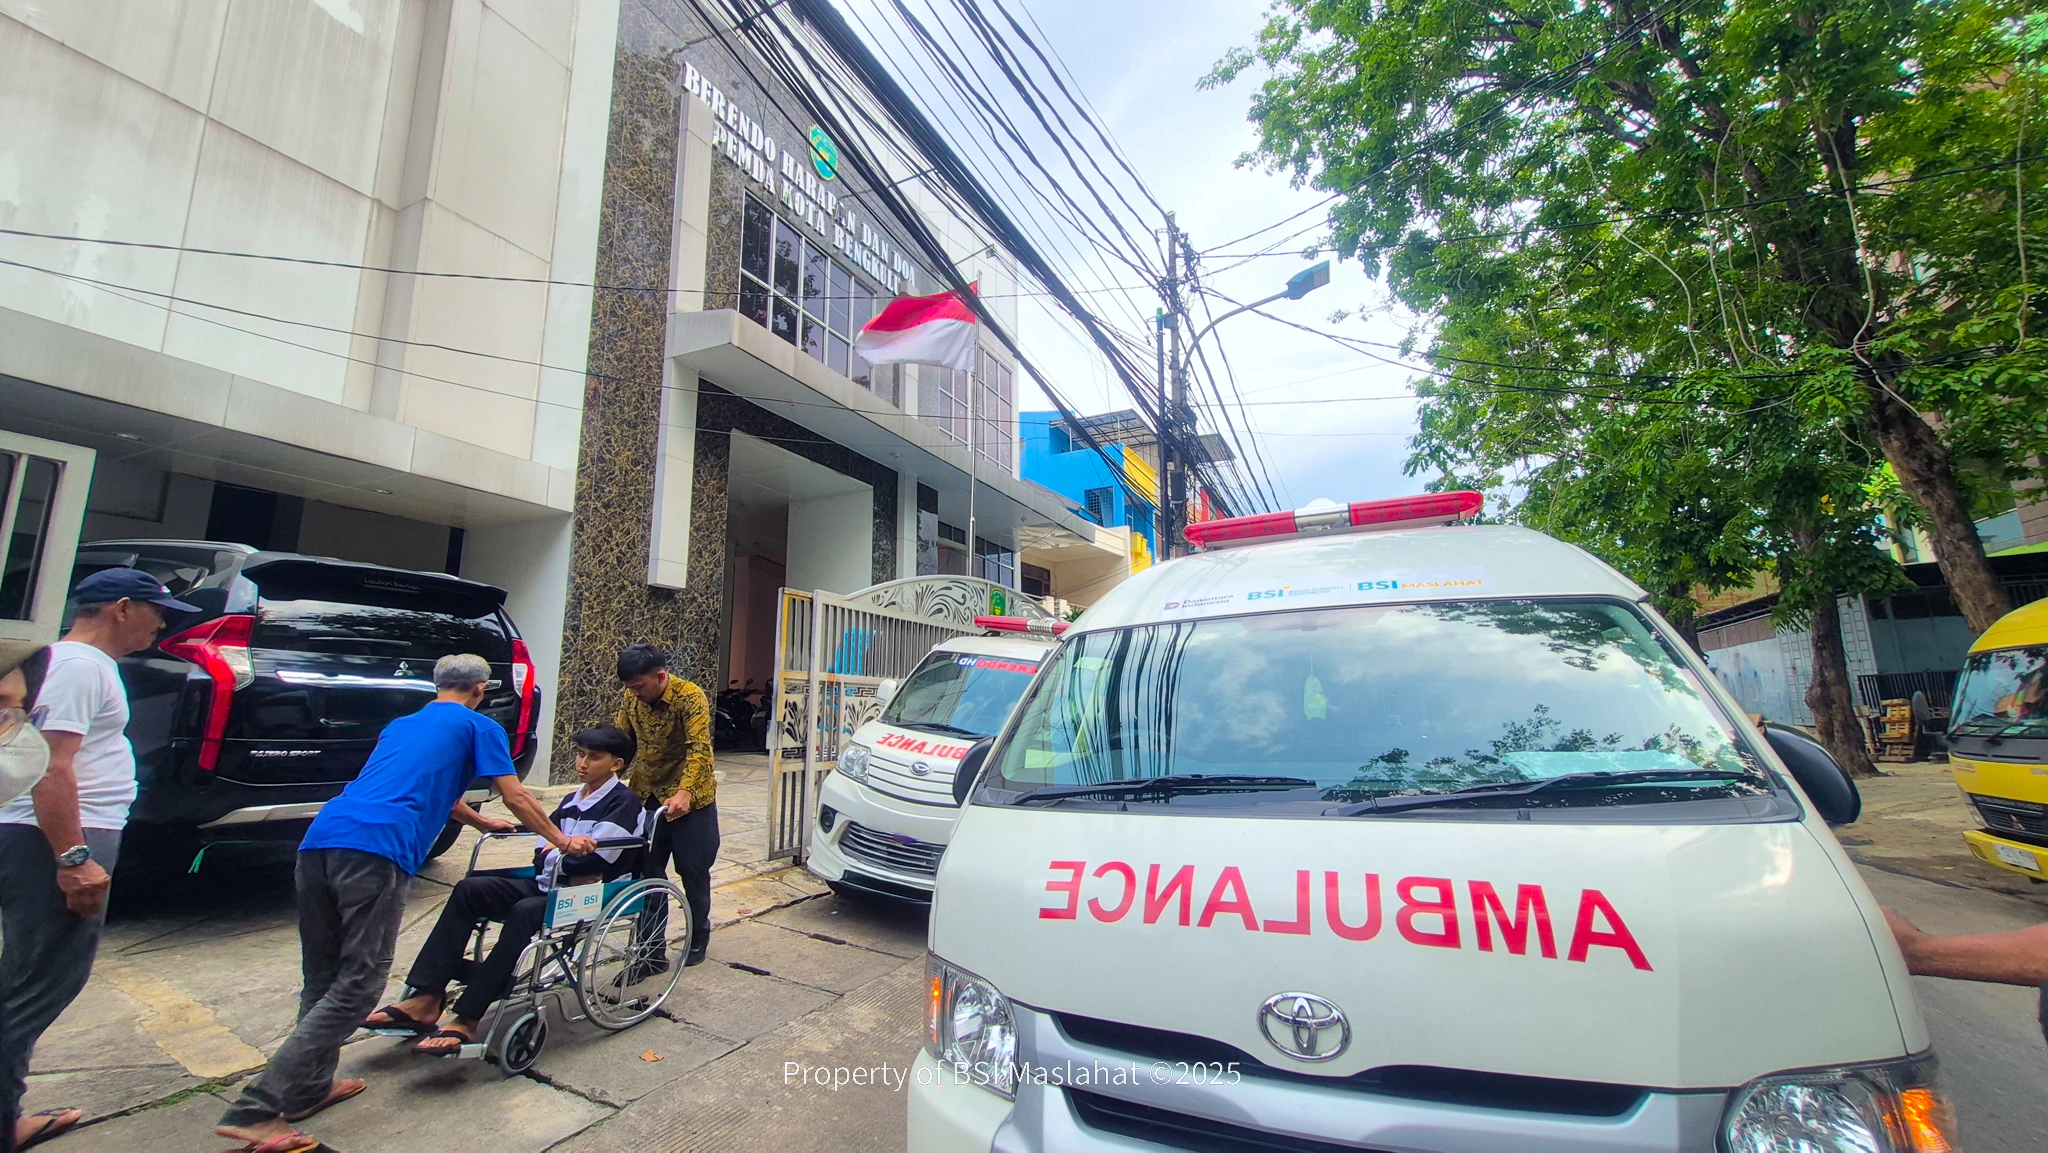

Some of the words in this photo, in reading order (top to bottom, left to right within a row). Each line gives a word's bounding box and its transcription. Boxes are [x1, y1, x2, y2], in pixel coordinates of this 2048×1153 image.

[683, 61, 776, 161] BERENDO
[862, 222, 889, 264] DAN
[893, 250, 916, 287] DOA
[712, 120, 776, 195] PEMDA
[781, 179, 826, 237] KOTA
[833, 223, 901, 297] BENGKULU
[1357, 580, 1398, 591] BSI
[1402, 579, 1484, 589] MASLAHAT
[1183, 594, 1234, 605] Danantara
[1247, 588, 1284, 600] BSI
[1182, 599, 1230, 609] Indonesia
[558, 898, 574, 910] BSI
[583, 895, 598, 906] BSI
